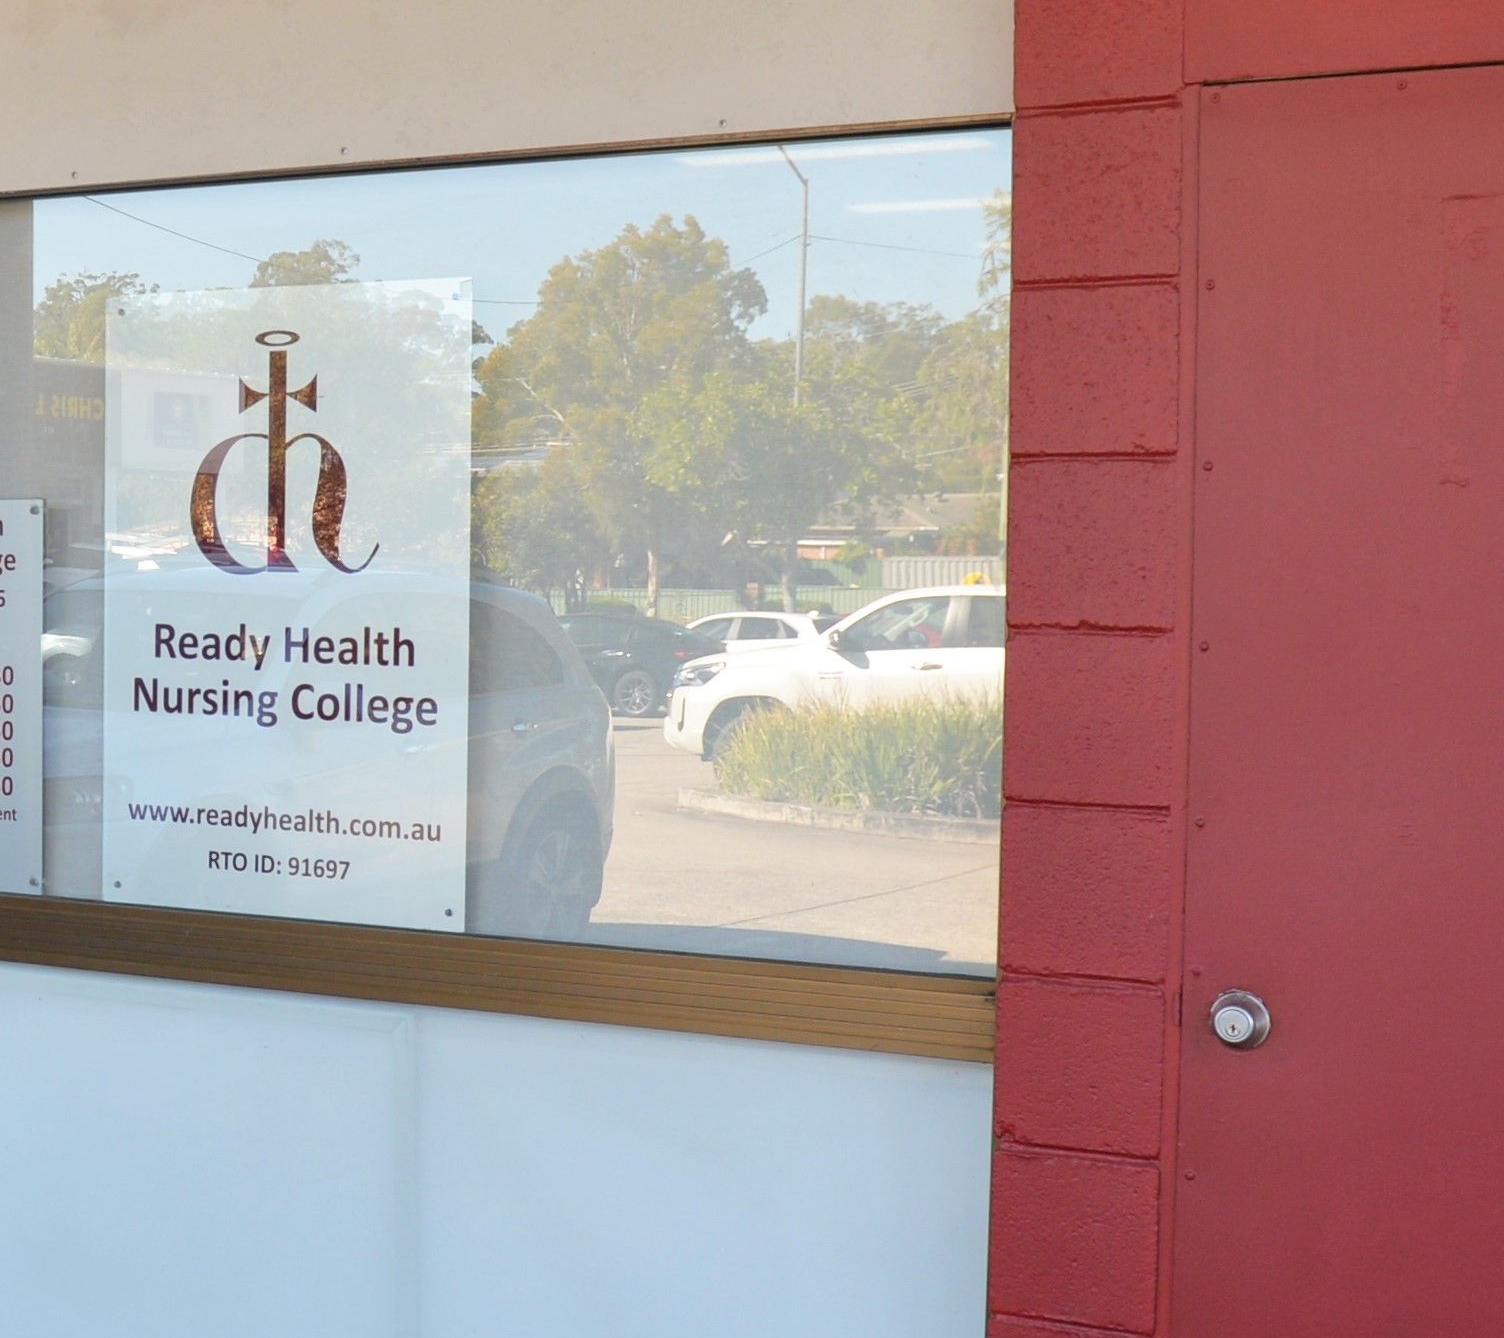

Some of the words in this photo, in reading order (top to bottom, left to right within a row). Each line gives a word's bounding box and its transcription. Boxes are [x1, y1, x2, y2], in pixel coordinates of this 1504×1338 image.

[153, 622, 271, 671] Ready
[284, 626, 416, 667] Health
[133, 677, 279, 727] Nursing
[291, 682, 438, 734] College
[128, 803, 442, 842] www.readyhealth.com.au
[208, 850, 248, 871] RTO
[254, 853, 281, 874] ID:
[288, 857, 350, 880] 91697
